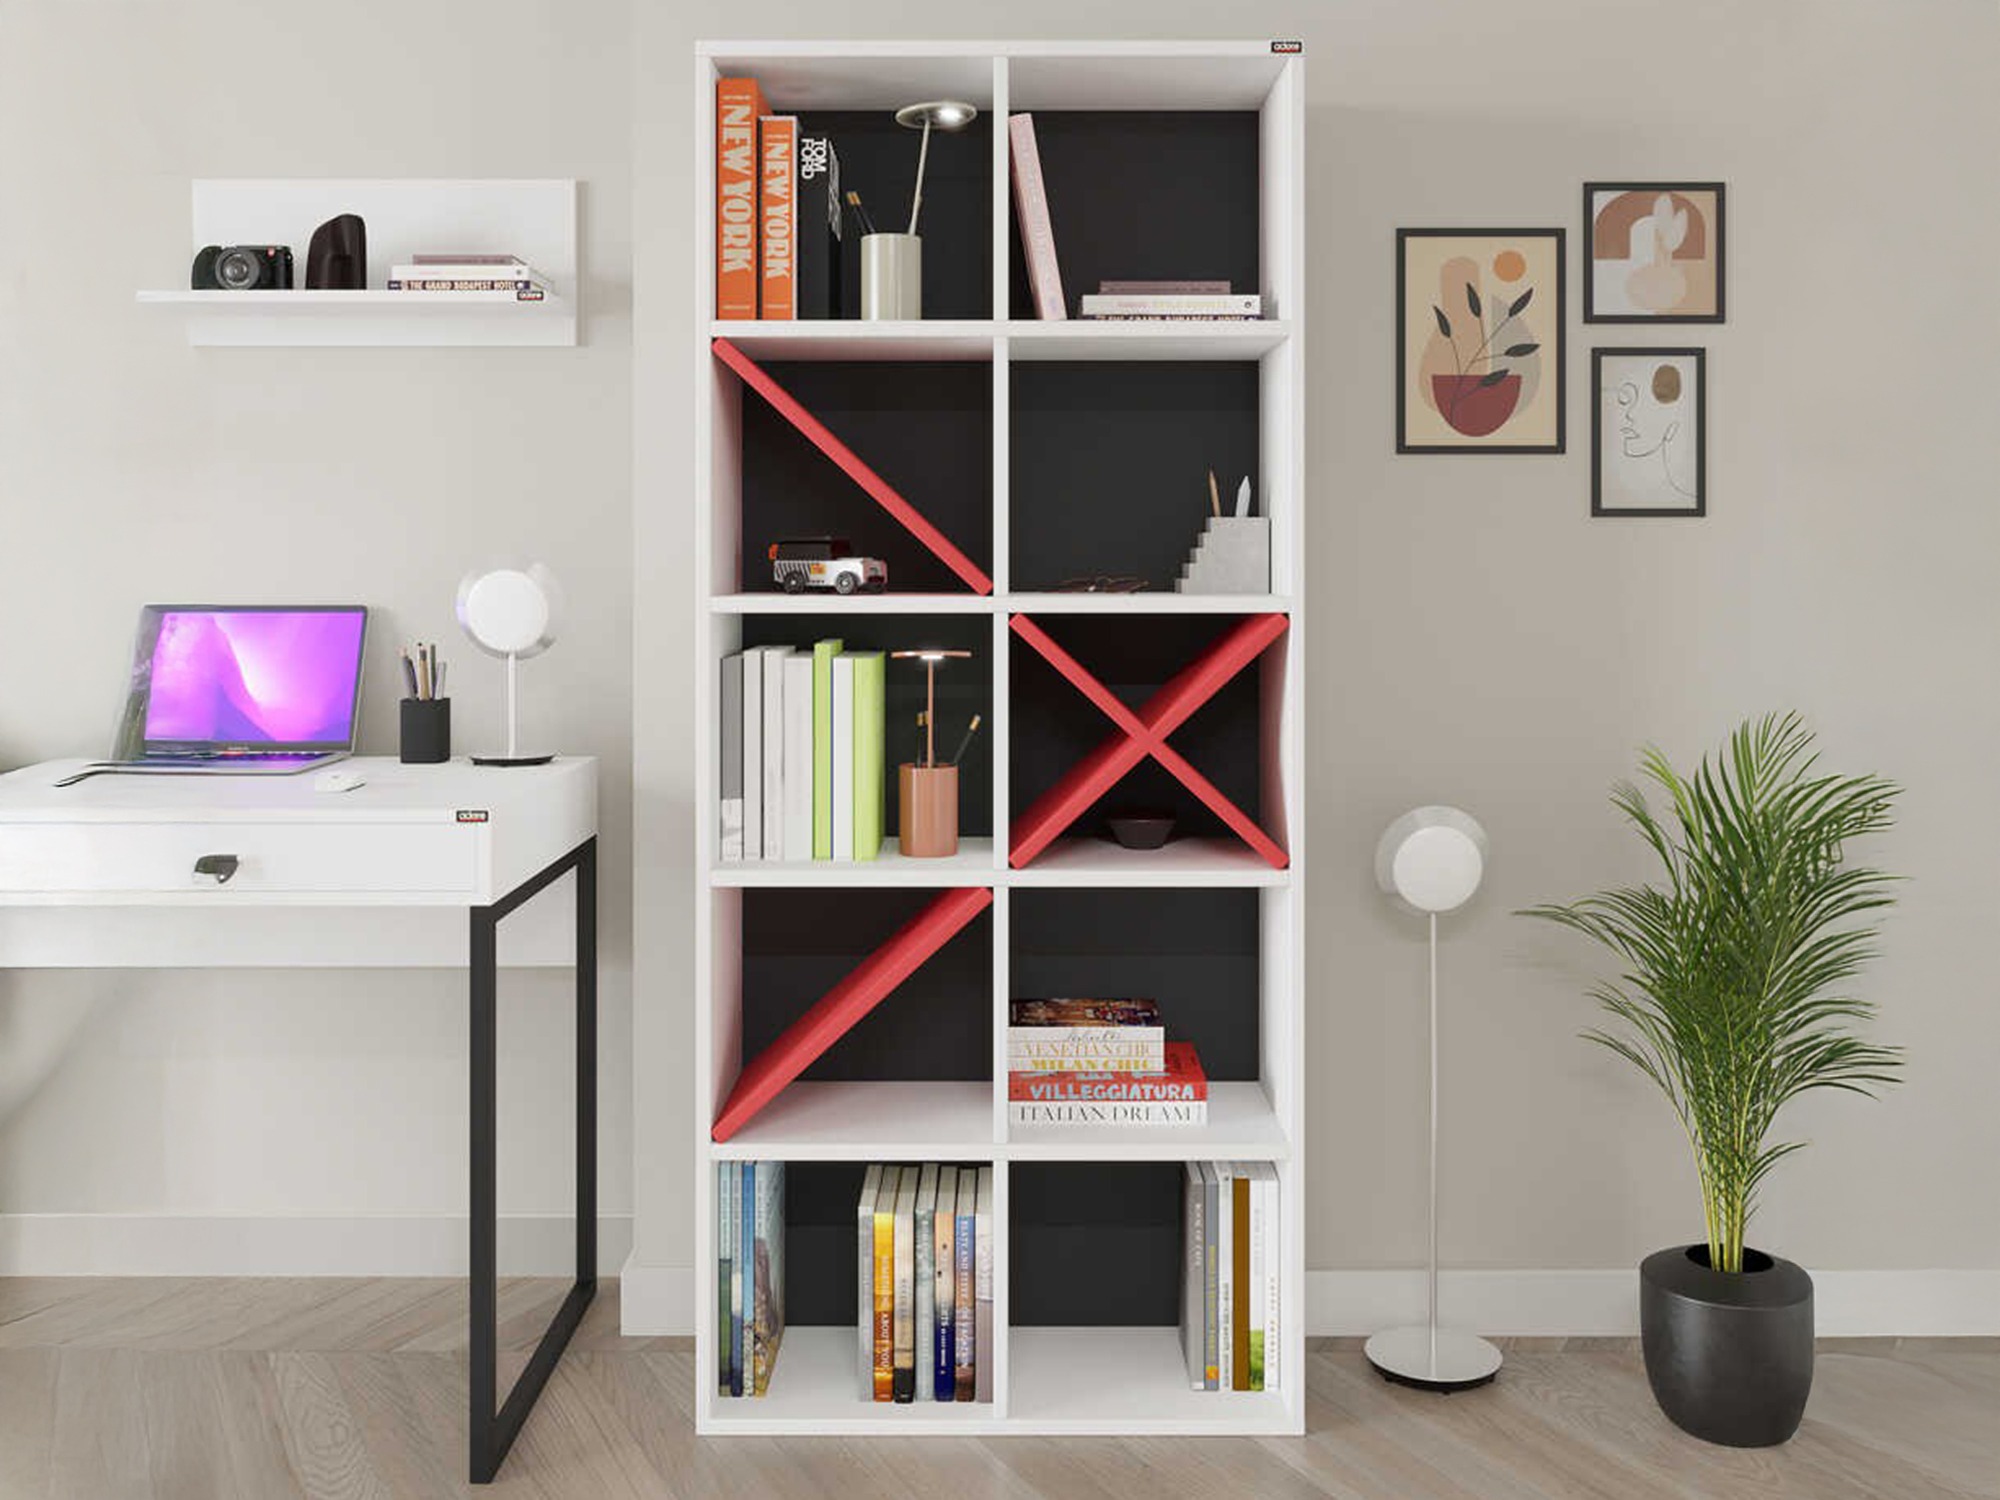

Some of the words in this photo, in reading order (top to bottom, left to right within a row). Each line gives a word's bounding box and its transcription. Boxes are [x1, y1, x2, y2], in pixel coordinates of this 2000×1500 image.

[722, 103, 752, 175] NEW
[813, 138, 828, 173] TOM
[765, 143, 791, 202] NEW
[800, 138, 814, 180] FORD
[722, 181, 752, 273] YORK
[765, 205, 791, 280] YORK
[1031, 1059, 1097, 1070] MILAN
[1101, 1059, 1150, 1070] CHIC
[1030, 1083, 1196, 1101] VILLEGGIATURA
[1019, 1105, 1107, 1122] ITALIAN
[1112, 1105, 1192, 1122] DREAM
[881, 1312, 890, 1344] ABOUT
[881, 1347, 890, 1368] YOU
